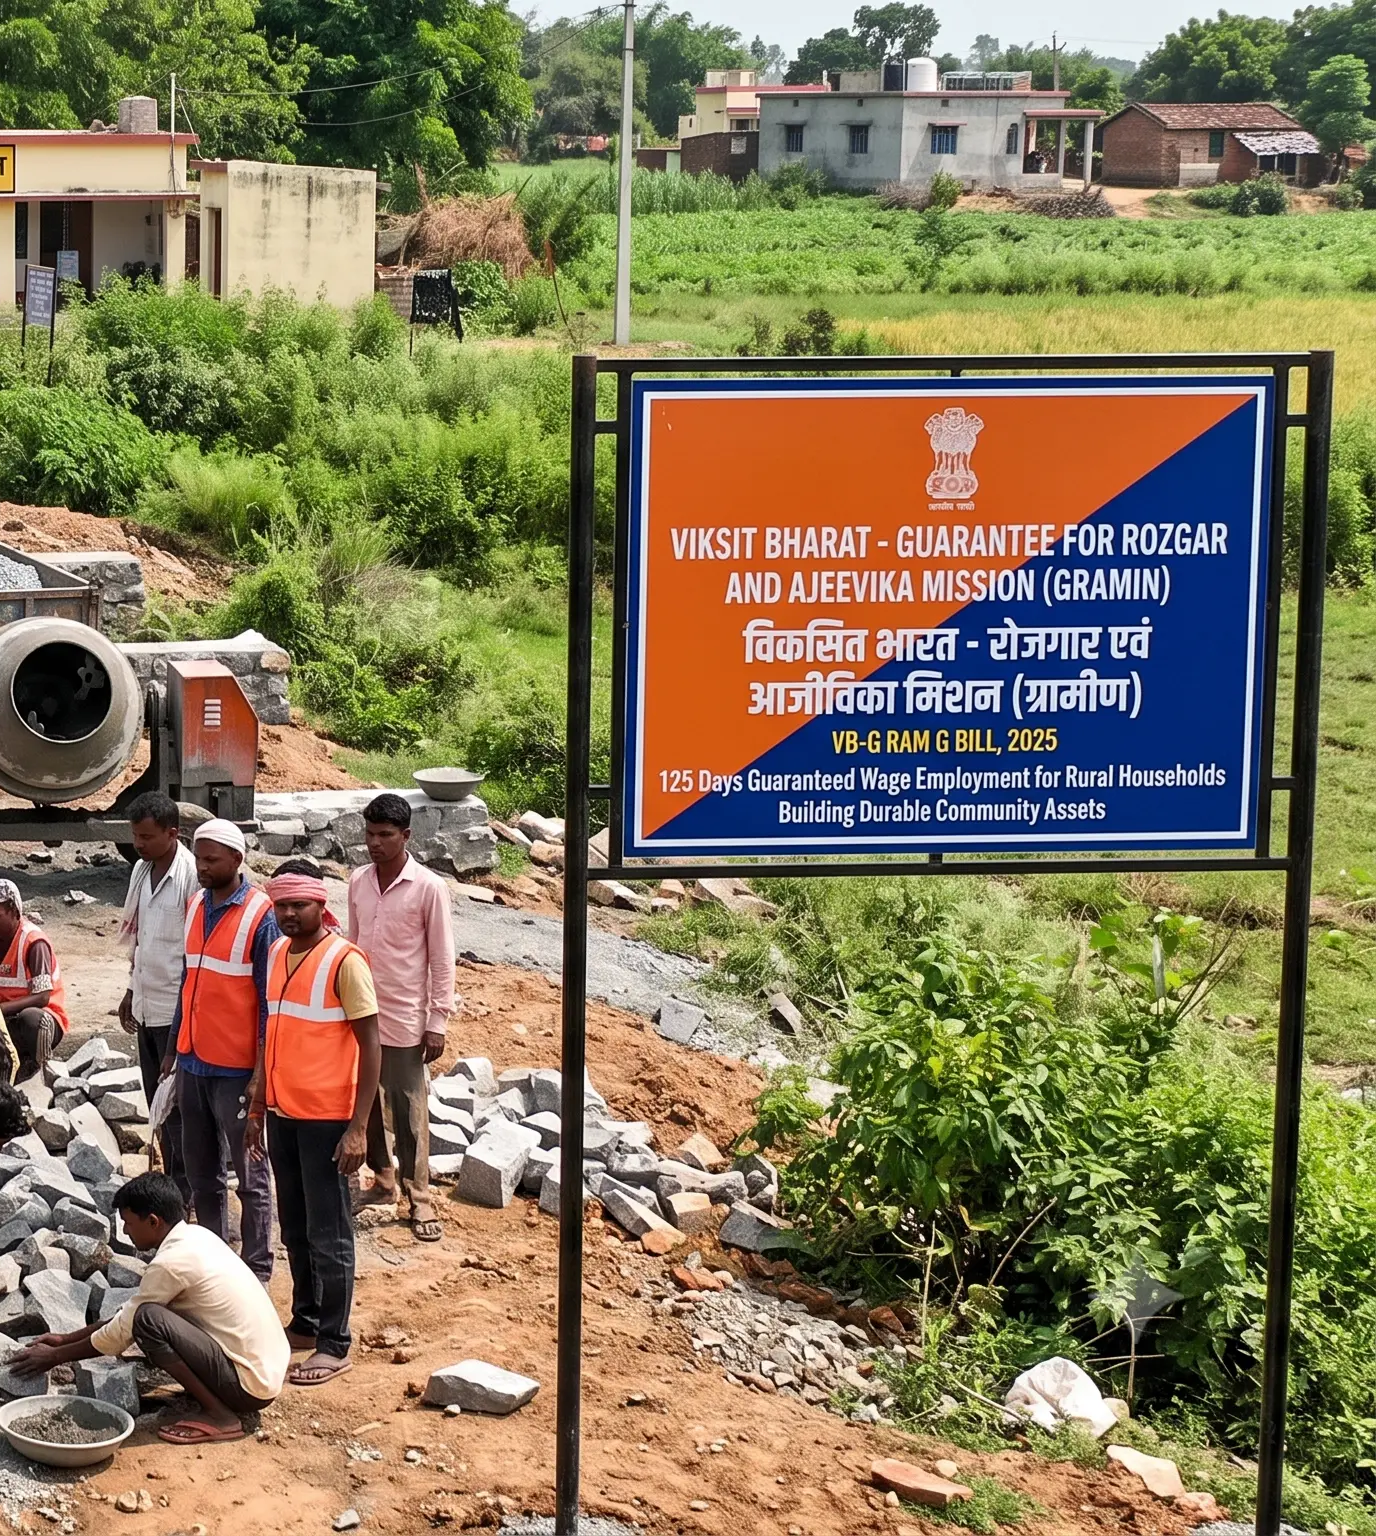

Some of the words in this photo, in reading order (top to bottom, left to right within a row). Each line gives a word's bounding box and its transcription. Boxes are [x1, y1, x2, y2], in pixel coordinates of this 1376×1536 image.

[670, 527, 757, 560] VIKSIT
[765, 526, 871, 559] BHARAT
[896, 525, 1056, 557] GUARANTEE
[1064, 524, 1115, 556] FOR
[1122, 523, 1228, 555] ROZGAR
[725, 572, 782, 604] AND
[788, 571, 915, 604] AJEEVIKA
[923, 569, 1035, 602] MISSION
[1044, 565, 1170, 607] (GRAMIN)
[741, 618, 869, 664] विकसित
[876, 628, 960, 662] भारत
[986, 617, 1103, 661] रोजगार
[1108, 616, 1153, 659] एवं
[747, 670, 899, 716] आजीविका
[903, 669, 1005, 714] मिशन
[1012, 668, 1142, 720] (ग्रामीण)
[833, 730, 881, 754] VB-G
[887, 730, 930, 754] RAM
[936, 729, 949, 753] G
[956, 729, 1002, 756] BILL,
[1008, 728, 1058, 752] 2025
[660, 769, 694, 793] 125
[699, 769, 743, 797] Days
[748, 767, 855, 792] Guaranteed
[860, 767, 911, 796] Wage
[916, 766, 1031, 795] Employment
[1035, 764, 1062, 788] for
[1066, 764, 1114, 788] Rural
[1119, 763, 1226, 787] Households
[780, 799, 855, 828] Building
[860, 799, 931, 822] Durable
[935, 797, 1041, 826] Community
[1044, 797, 1106, 820] Assets
